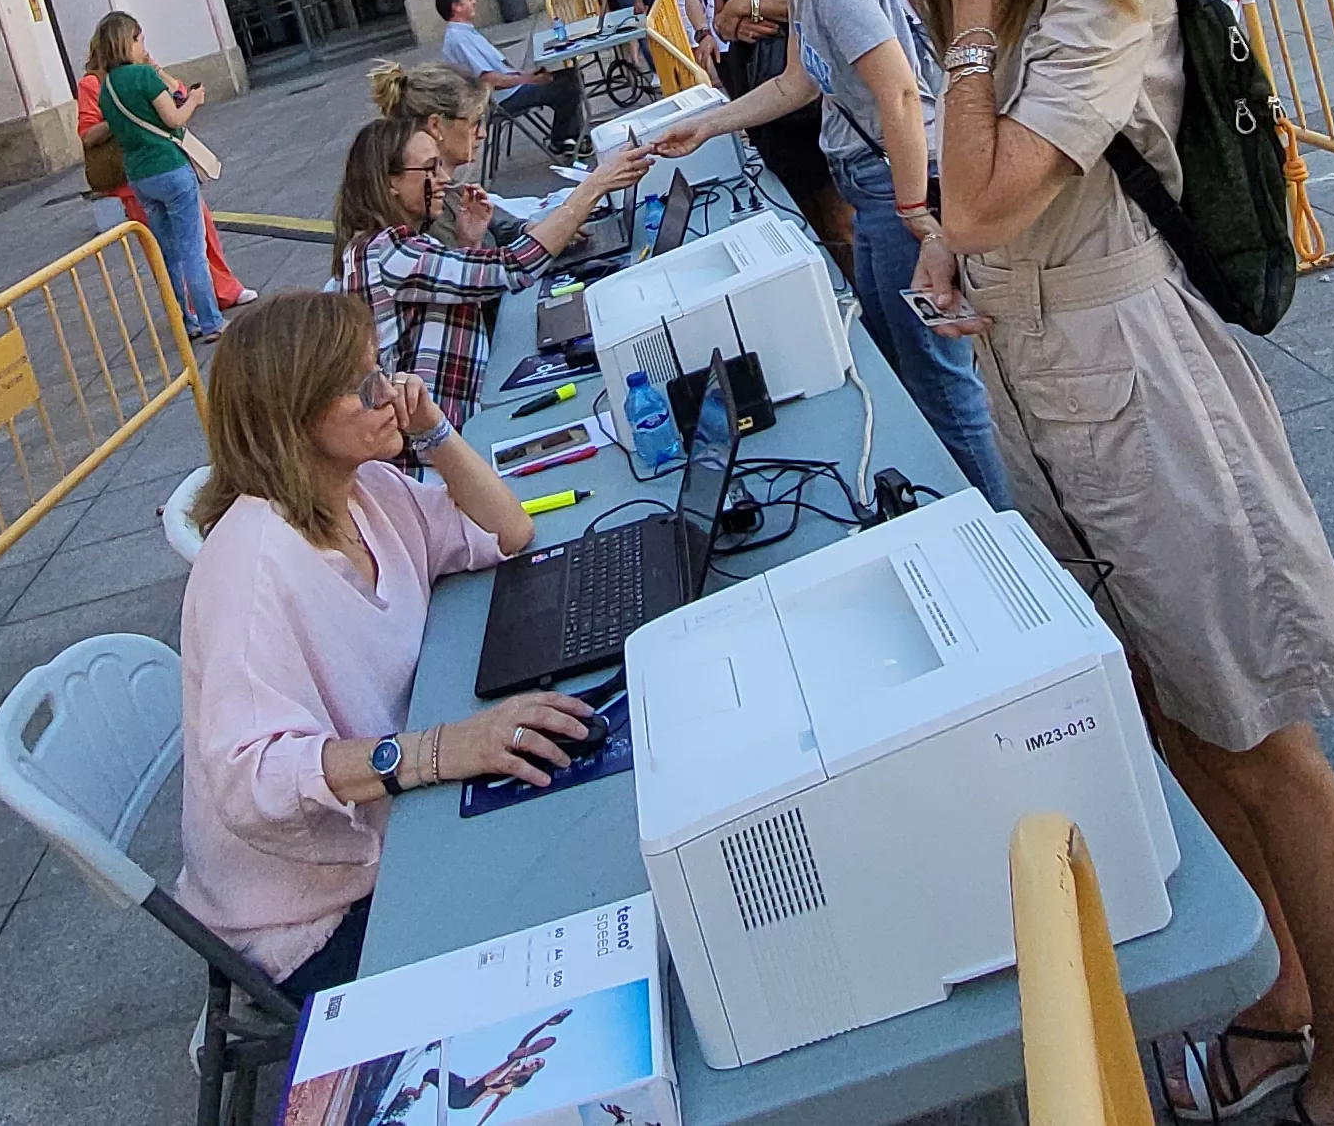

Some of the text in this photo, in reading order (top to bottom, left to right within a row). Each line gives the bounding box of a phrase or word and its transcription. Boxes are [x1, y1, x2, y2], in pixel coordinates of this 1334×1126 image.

[1025, 716, 1096, 752] IM23-013
[592, 913, 614, 957] speed
[616, 905, 633, 950] tecno
